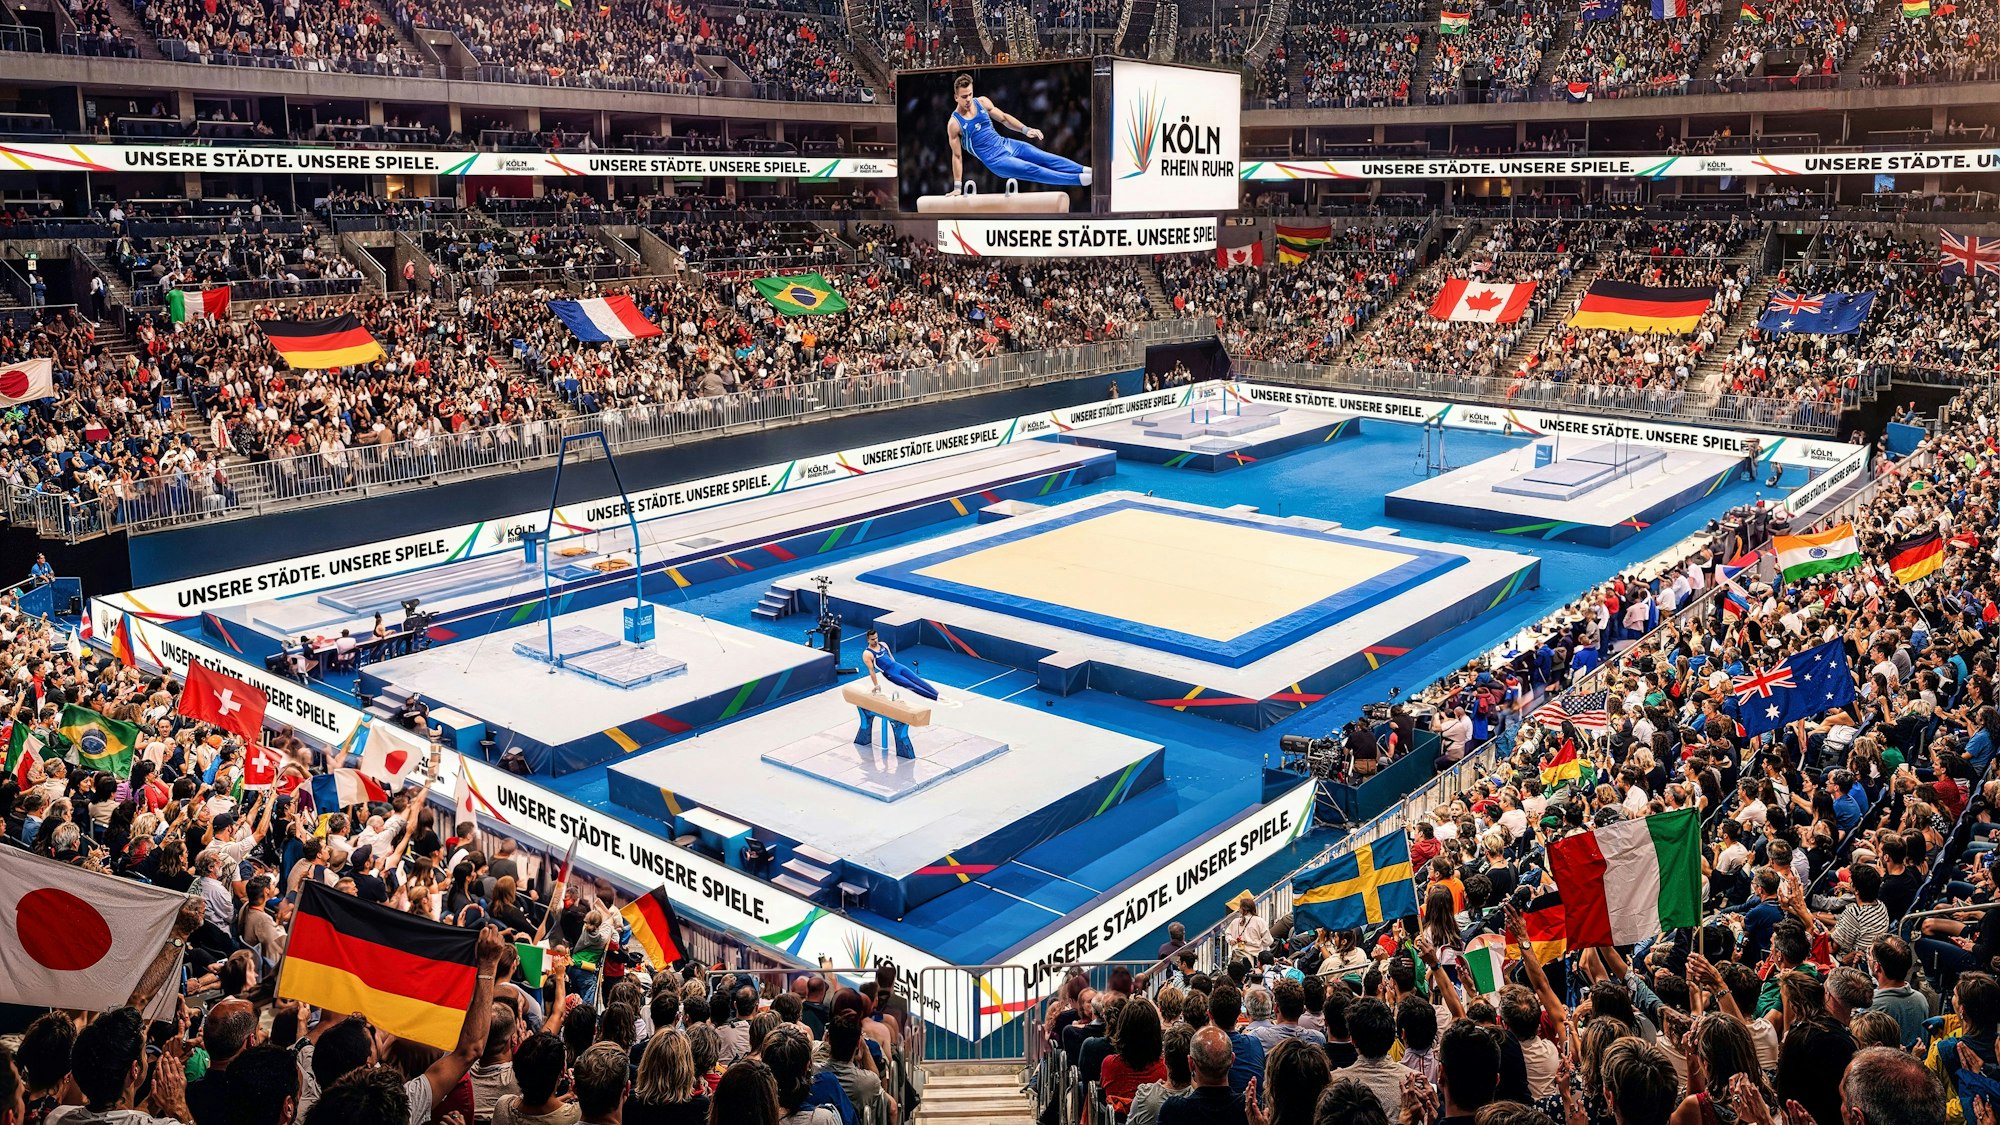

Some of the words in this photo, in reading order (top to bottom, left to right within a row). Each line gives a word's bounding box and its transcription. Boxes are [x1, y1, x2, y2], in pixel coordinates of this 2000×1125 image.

[1162, 115, 1220, 155] KÖLN
[125, 151, 208, 167] UNSERE
[213, 149, 293, 168] STÄDTE.
[299, 155, 371, 169] UNSERE
[376, 155, 439, 170] SPIELE.
[589, 159, 647, 172] UNSERE
[650, 156, 706, 172] STÄDTE.
[709, 161, 761, 173] UNSERE
[765, 162, 811, 173] SPIELE.
[1161, 159, 1199, 177] RHEIN
[1203, 161, 1234, 177] RUHR
[1362, 164, 1425, 175] UNSERE
[1429, 160, 1495, 175] STÄDTE.
[1500, 163, 1566, 174] UNSERE
[1572, 161, 1635, 173] SPIELE.
[1805, 157, 1882, 170] UNSERE
[1887, 153, 1970, 169] STÄDTE.
[987, 230, 1052, 247] UNSERE
[1059, 225, 1131, 247] STÄDTE.
[1138, 228, 1190, 246] UNSERE
[1070, 408, 1097, 423] UNSERE
[1098, 401, 1125, 418] STÄDTE.
[1126, 398, 1153, 413] UNSERE
[1153, 393, 1177, 407] SPIELE.
[1251, 389, 1292, 403] UNSERE
[1295, 392, 1337, 408] STÄDTE.
[1340, 399, 1383, 413] UNSERE
[1385, 403, 1424, 418] SPIELE.
[1540, 419, 1589, 434] UNSERE
[1592, 423, 1643, 440] STÄDTE.
[1646, 430, 1698, 445] UNSERE
[862, 448, 899, 466] UNSERE
[900, 441, 935, 459] STÄDTE.
[936, 434, 969, 451] UNSERE
[971, 429, 999, 445] SPIELE.
[587, 501, 635, 522] UNSERE
[638, 492, 685, 511] STÄDTE.
[687, 483, 729, 501] UNSERE
[733, 475, 771, 493] SPIELE.
[507, 524, 535, 537] KÖLN
[178, 578, 253, 608] UNSERE
[257, 565, 325, 590] STÄDTE.
[330, 551, 392, 576] UNSERE
[396, 540, 449, 562] SPIELE.
[297, 699, 338, 733] SPIELE.
[498, 786, 556, 829] UNSERE
[561, 814, 625, 860] STÄDTE.
[630, 844, 697, 892] UNSERE
[703, 877, 768, 924] SPIELE.
[1024, 925, 1099, 988] UNSERE
[1104, 884, 1172, 941] STÄDTE.
[1177, 842, 1237, 895] UNSERE
[1241, 810, 1292, 856] SPIELE.
